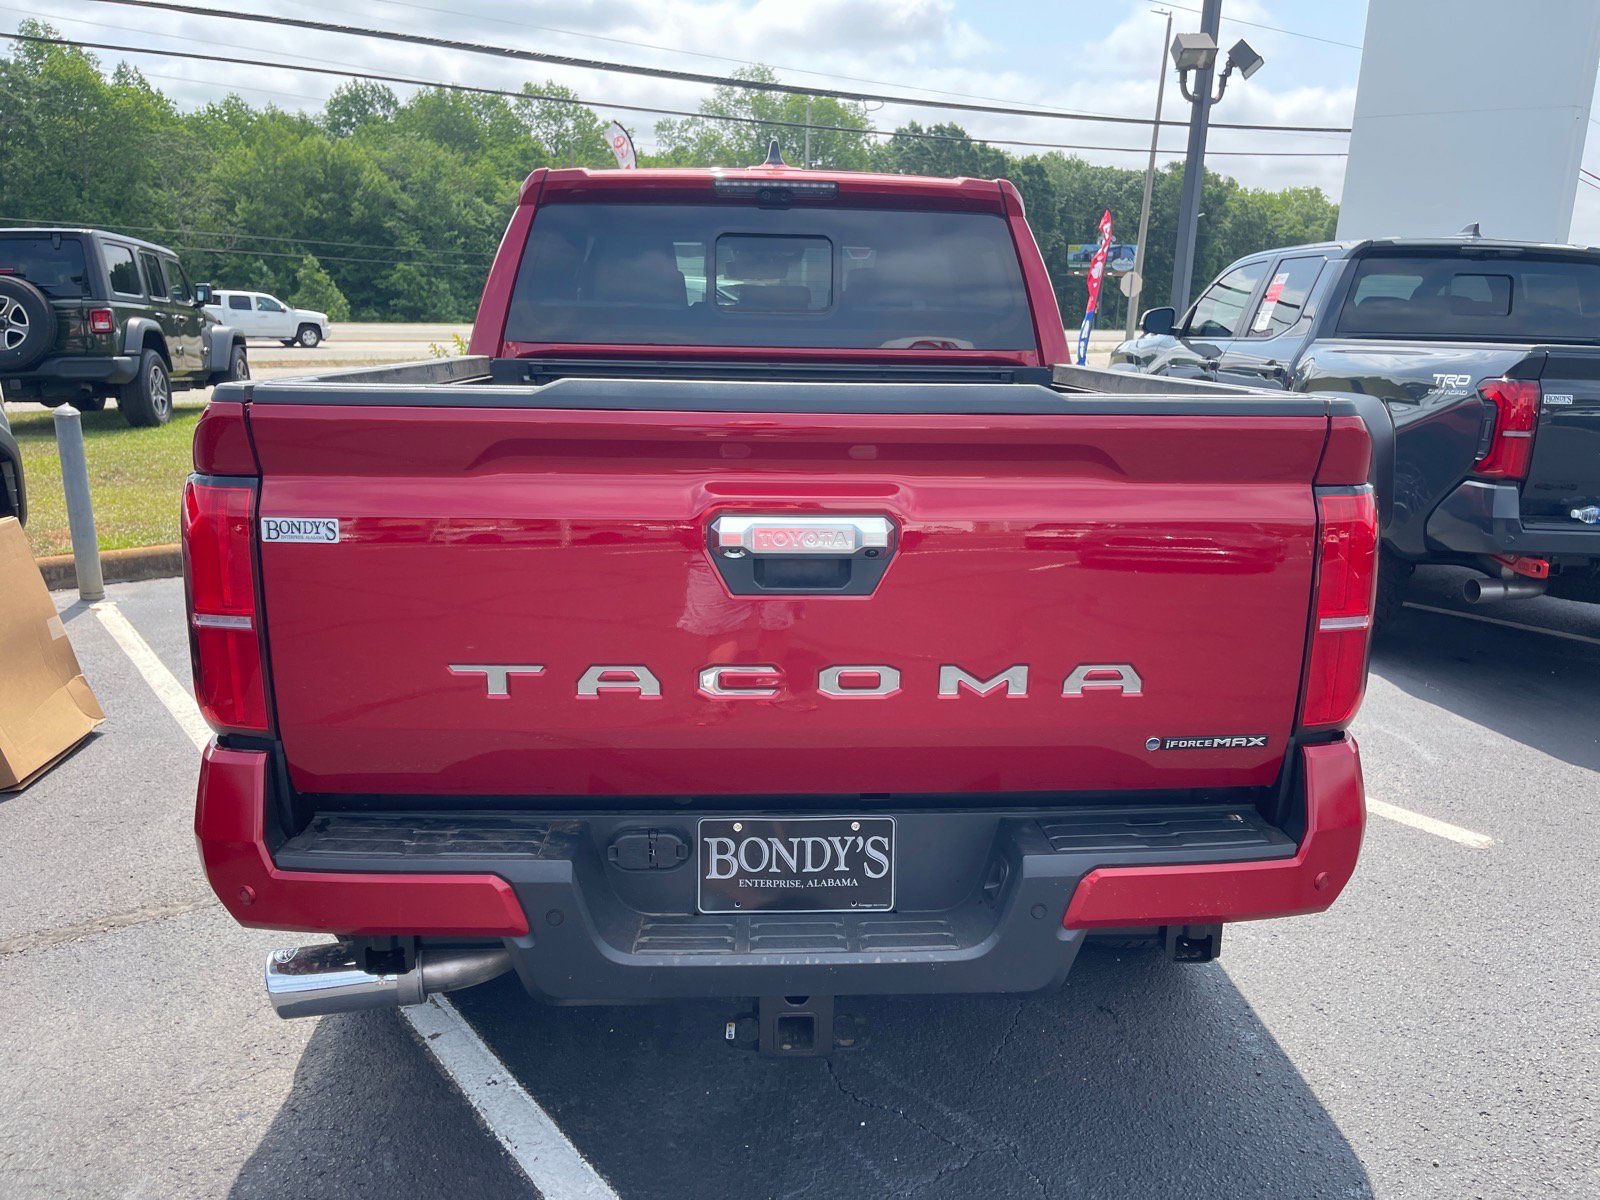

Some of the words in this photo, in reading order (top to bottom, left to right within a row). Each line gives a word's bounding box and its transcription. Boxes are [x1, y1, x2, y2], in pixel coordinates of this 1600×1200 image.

[1433, 373, 1471, 388] TRD
[264, 519, 337, 541] BONDY'S
[758, 530, 849, 547] TOYOTA
[448, 664, 1143, 699] TACOMA
[704, 836, 890, 880] BONDY'S
[738, 878, 804, 889] ENTERPRISE,
[806, 877, 859, 888] ALABAMA
